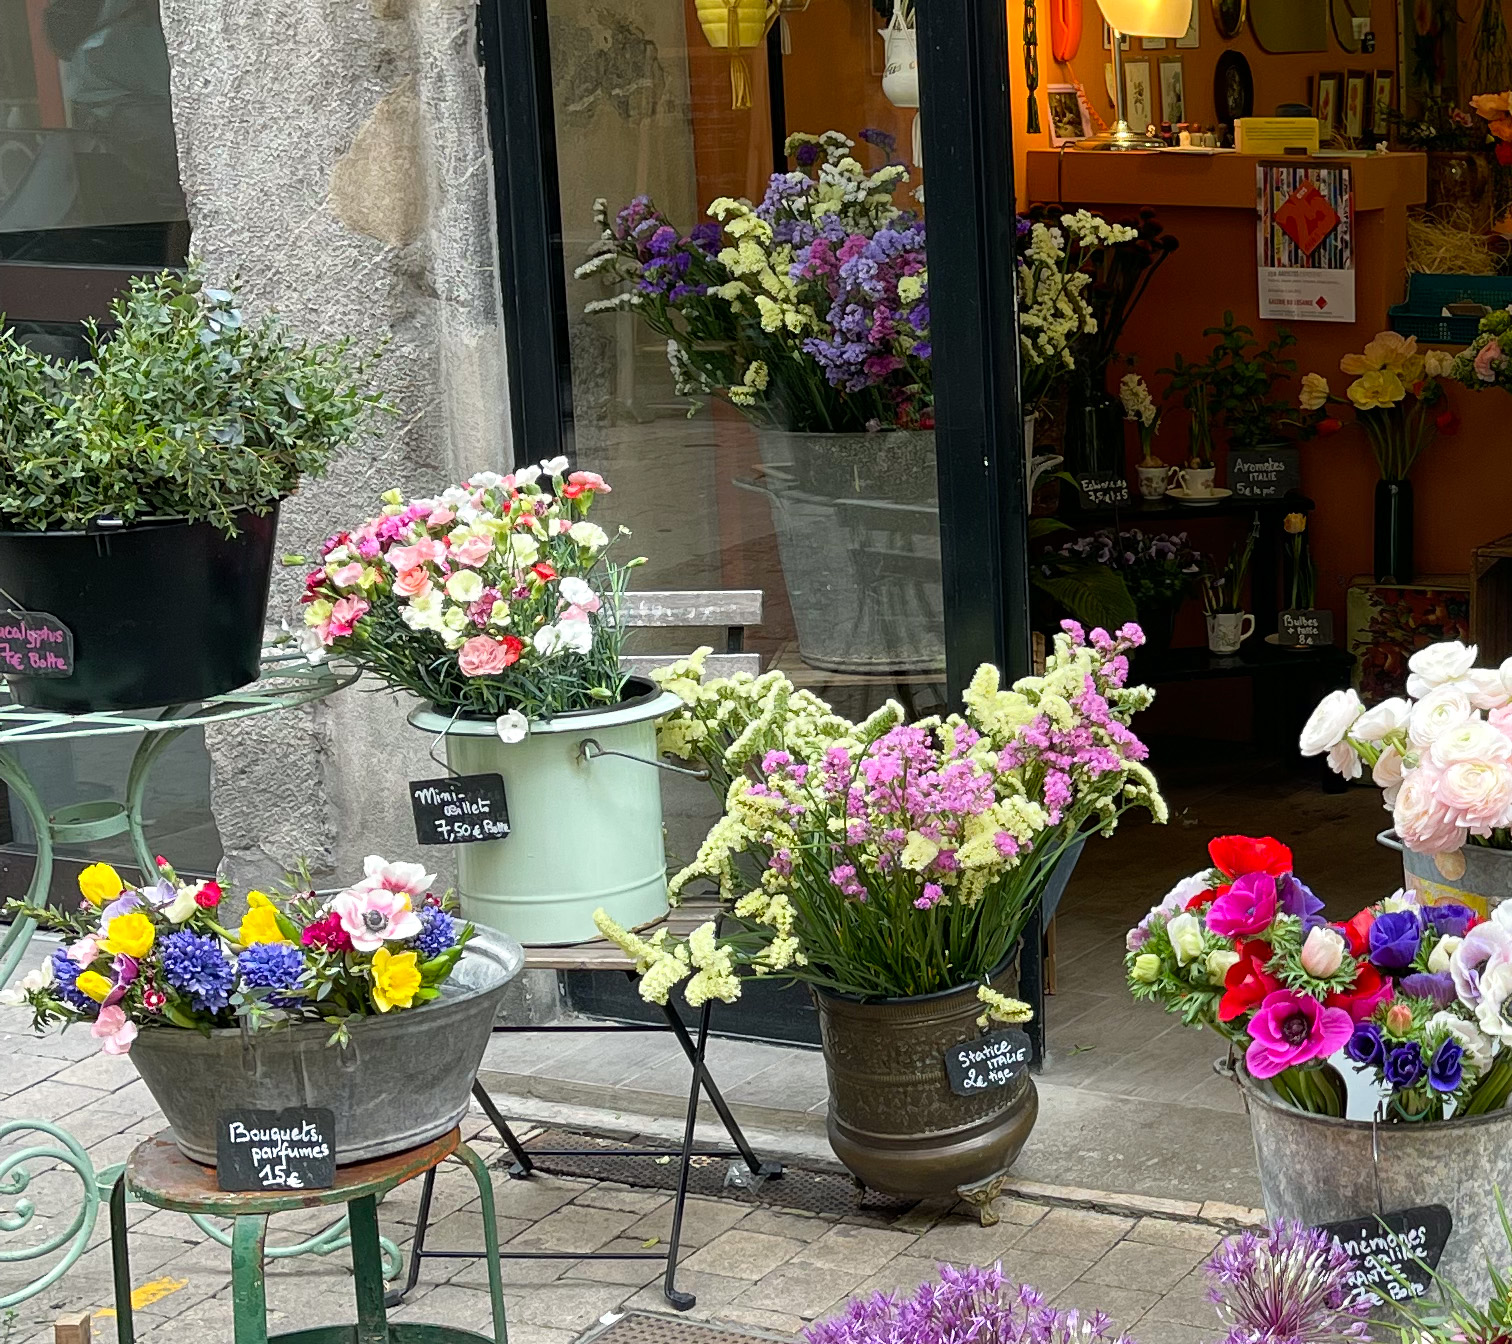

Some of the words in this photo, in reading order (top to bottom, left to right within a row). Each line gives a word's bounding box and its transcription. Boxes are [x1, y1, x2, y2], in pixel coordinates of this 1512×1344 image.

[1249, 471, 1278, 482] ITALIE
[1283, 614, 1319, 627] Bulbes
[27, 651, 68, 670] Botte
[414, 785, 466, 806] Mini-
[958, 1039, 1012, 1068] Statice
[986, 1047, 1027, 1070] ITALIE
[987, 1068, 1014, 1085] tige
[258, 1163, 304, 1188] 15€
